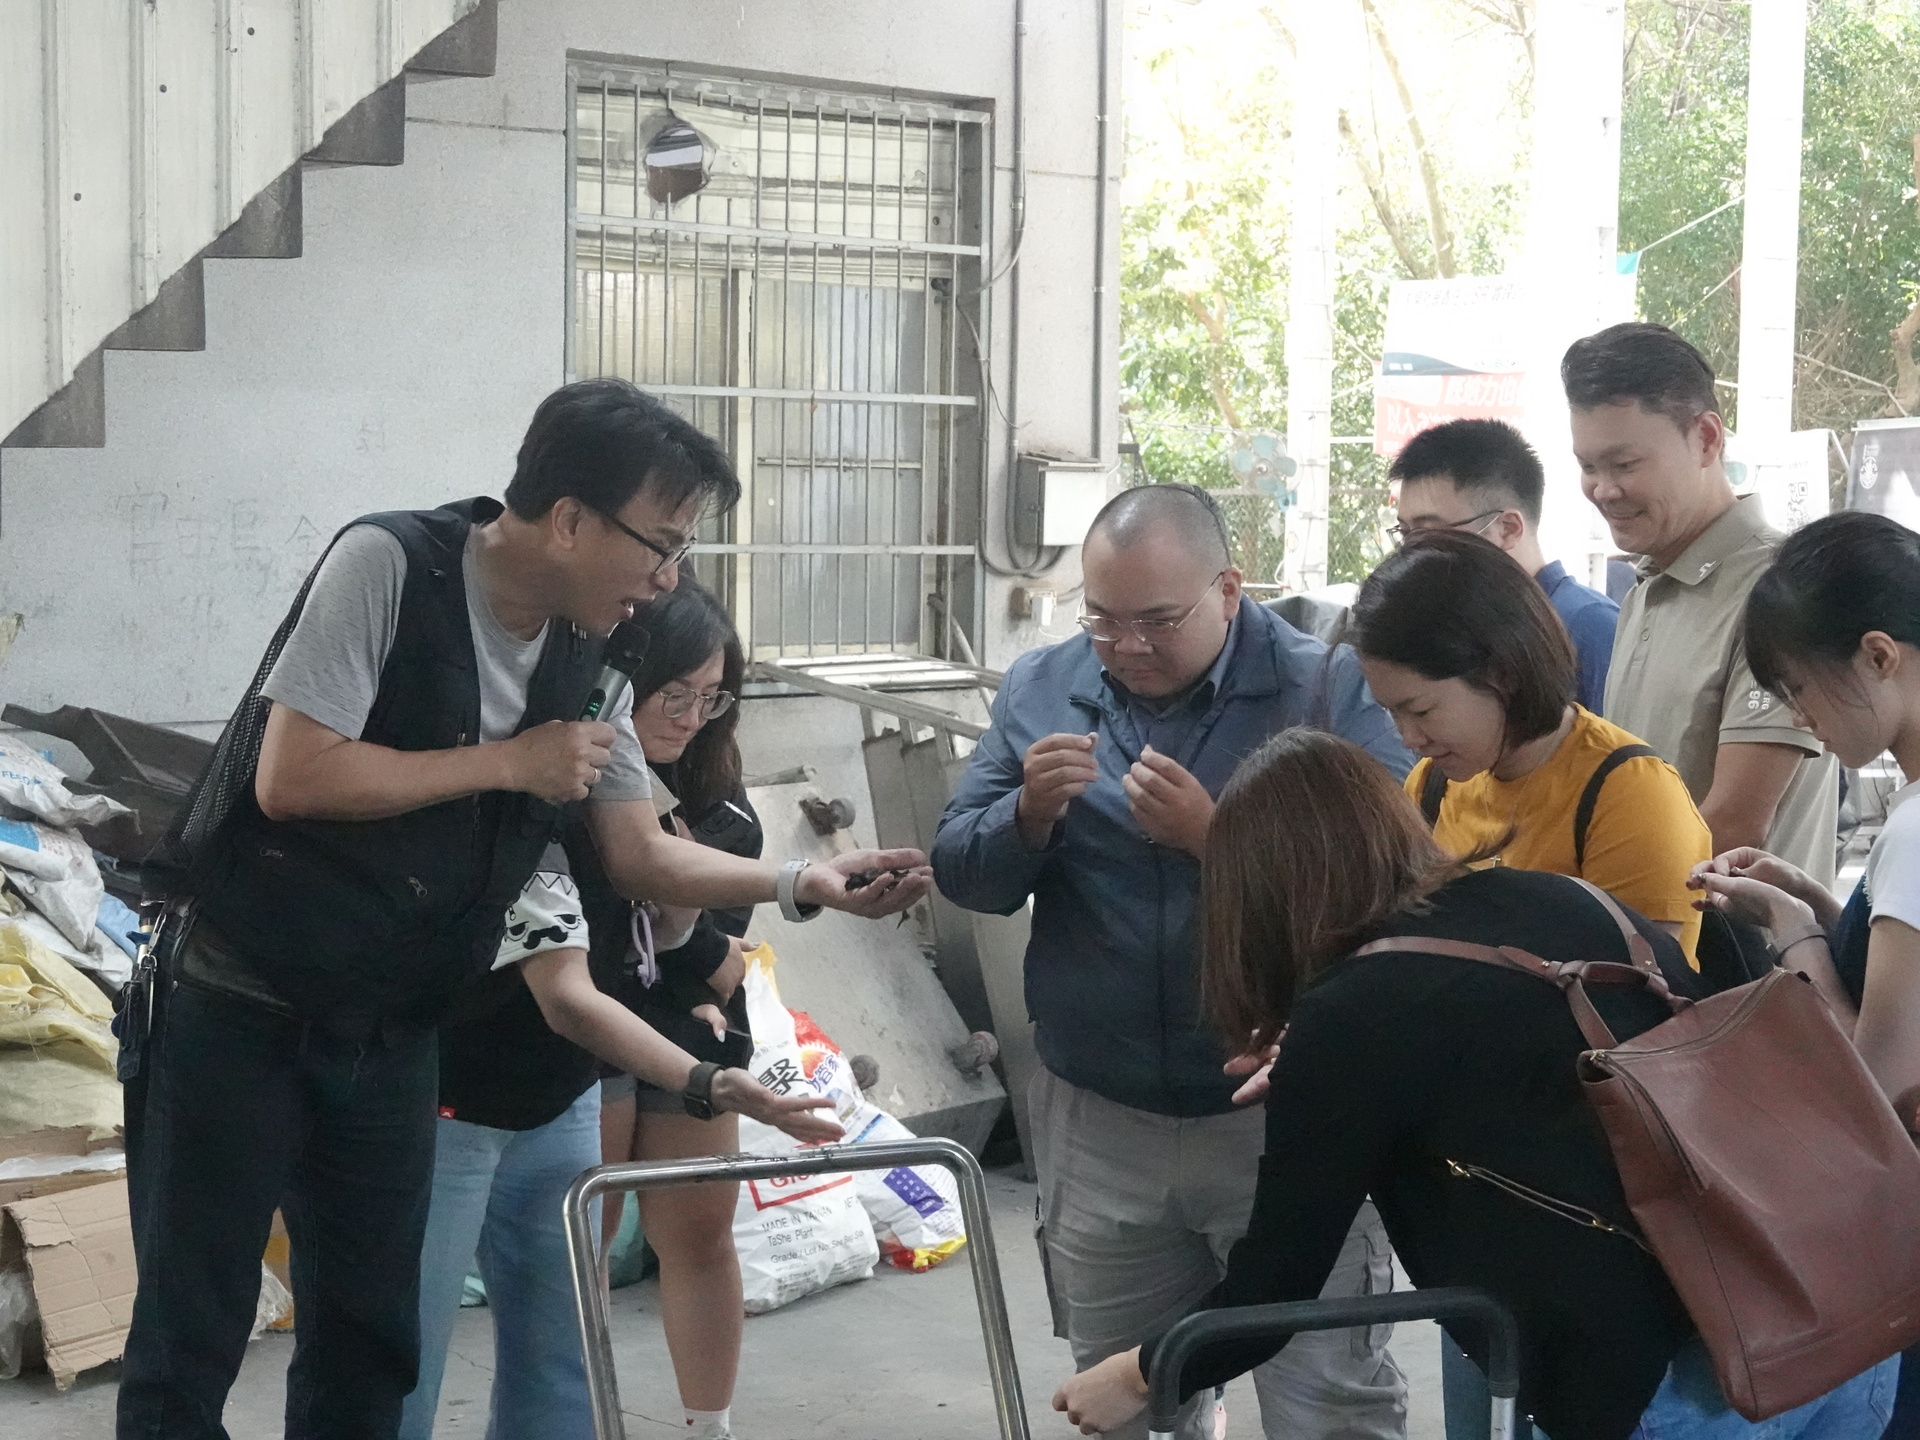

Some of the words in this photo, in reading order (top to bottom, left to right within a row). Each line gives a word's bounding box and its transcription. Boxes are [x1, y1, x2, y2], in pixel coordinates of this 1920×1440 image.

[758, 1058, 804, 1096] 聚
[762, 1217, 788, 1232] MADE
[792, 1212, 802, 1224] IN
[767, 1233, 792, 1247] TaShe
[795, 1228, 814, 1240] Plant
[770, 1251, 798, 1263] Grade
[804, 1245, 817, 1256] Lot
